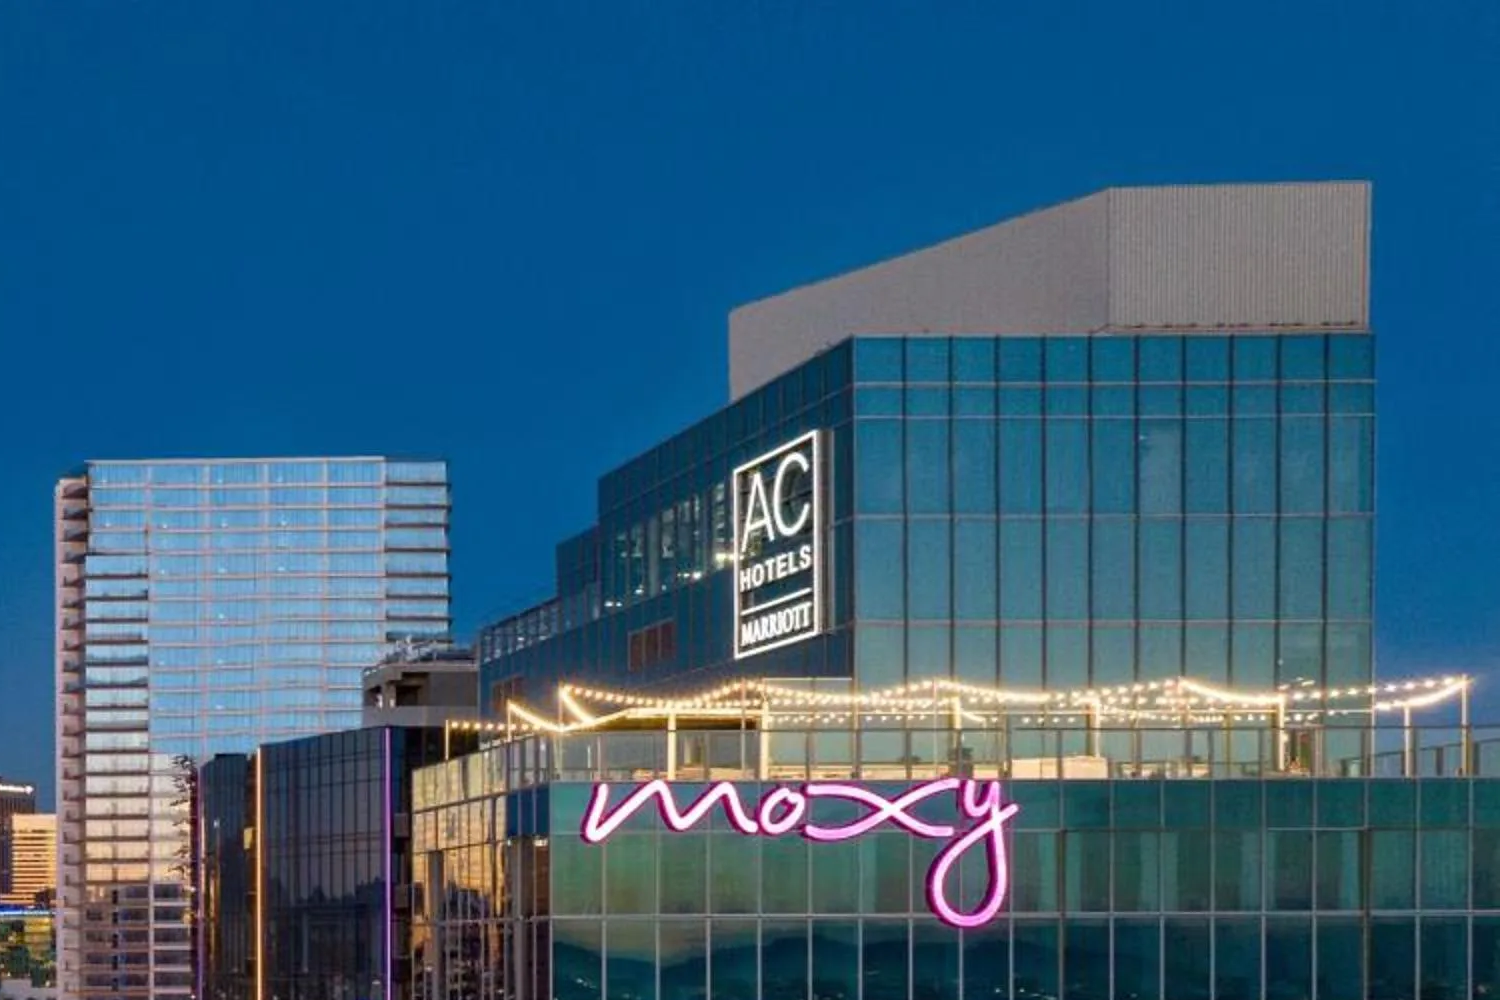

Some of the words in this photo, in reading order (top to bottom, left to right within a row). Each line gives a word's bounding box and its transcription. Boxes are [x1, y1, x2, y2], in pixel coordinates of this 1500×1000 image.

[740, 452, 810, 556] AC
[739, 545, 813, 593] HOTELS
[740, 602, 813, 647] MARRIOTT
